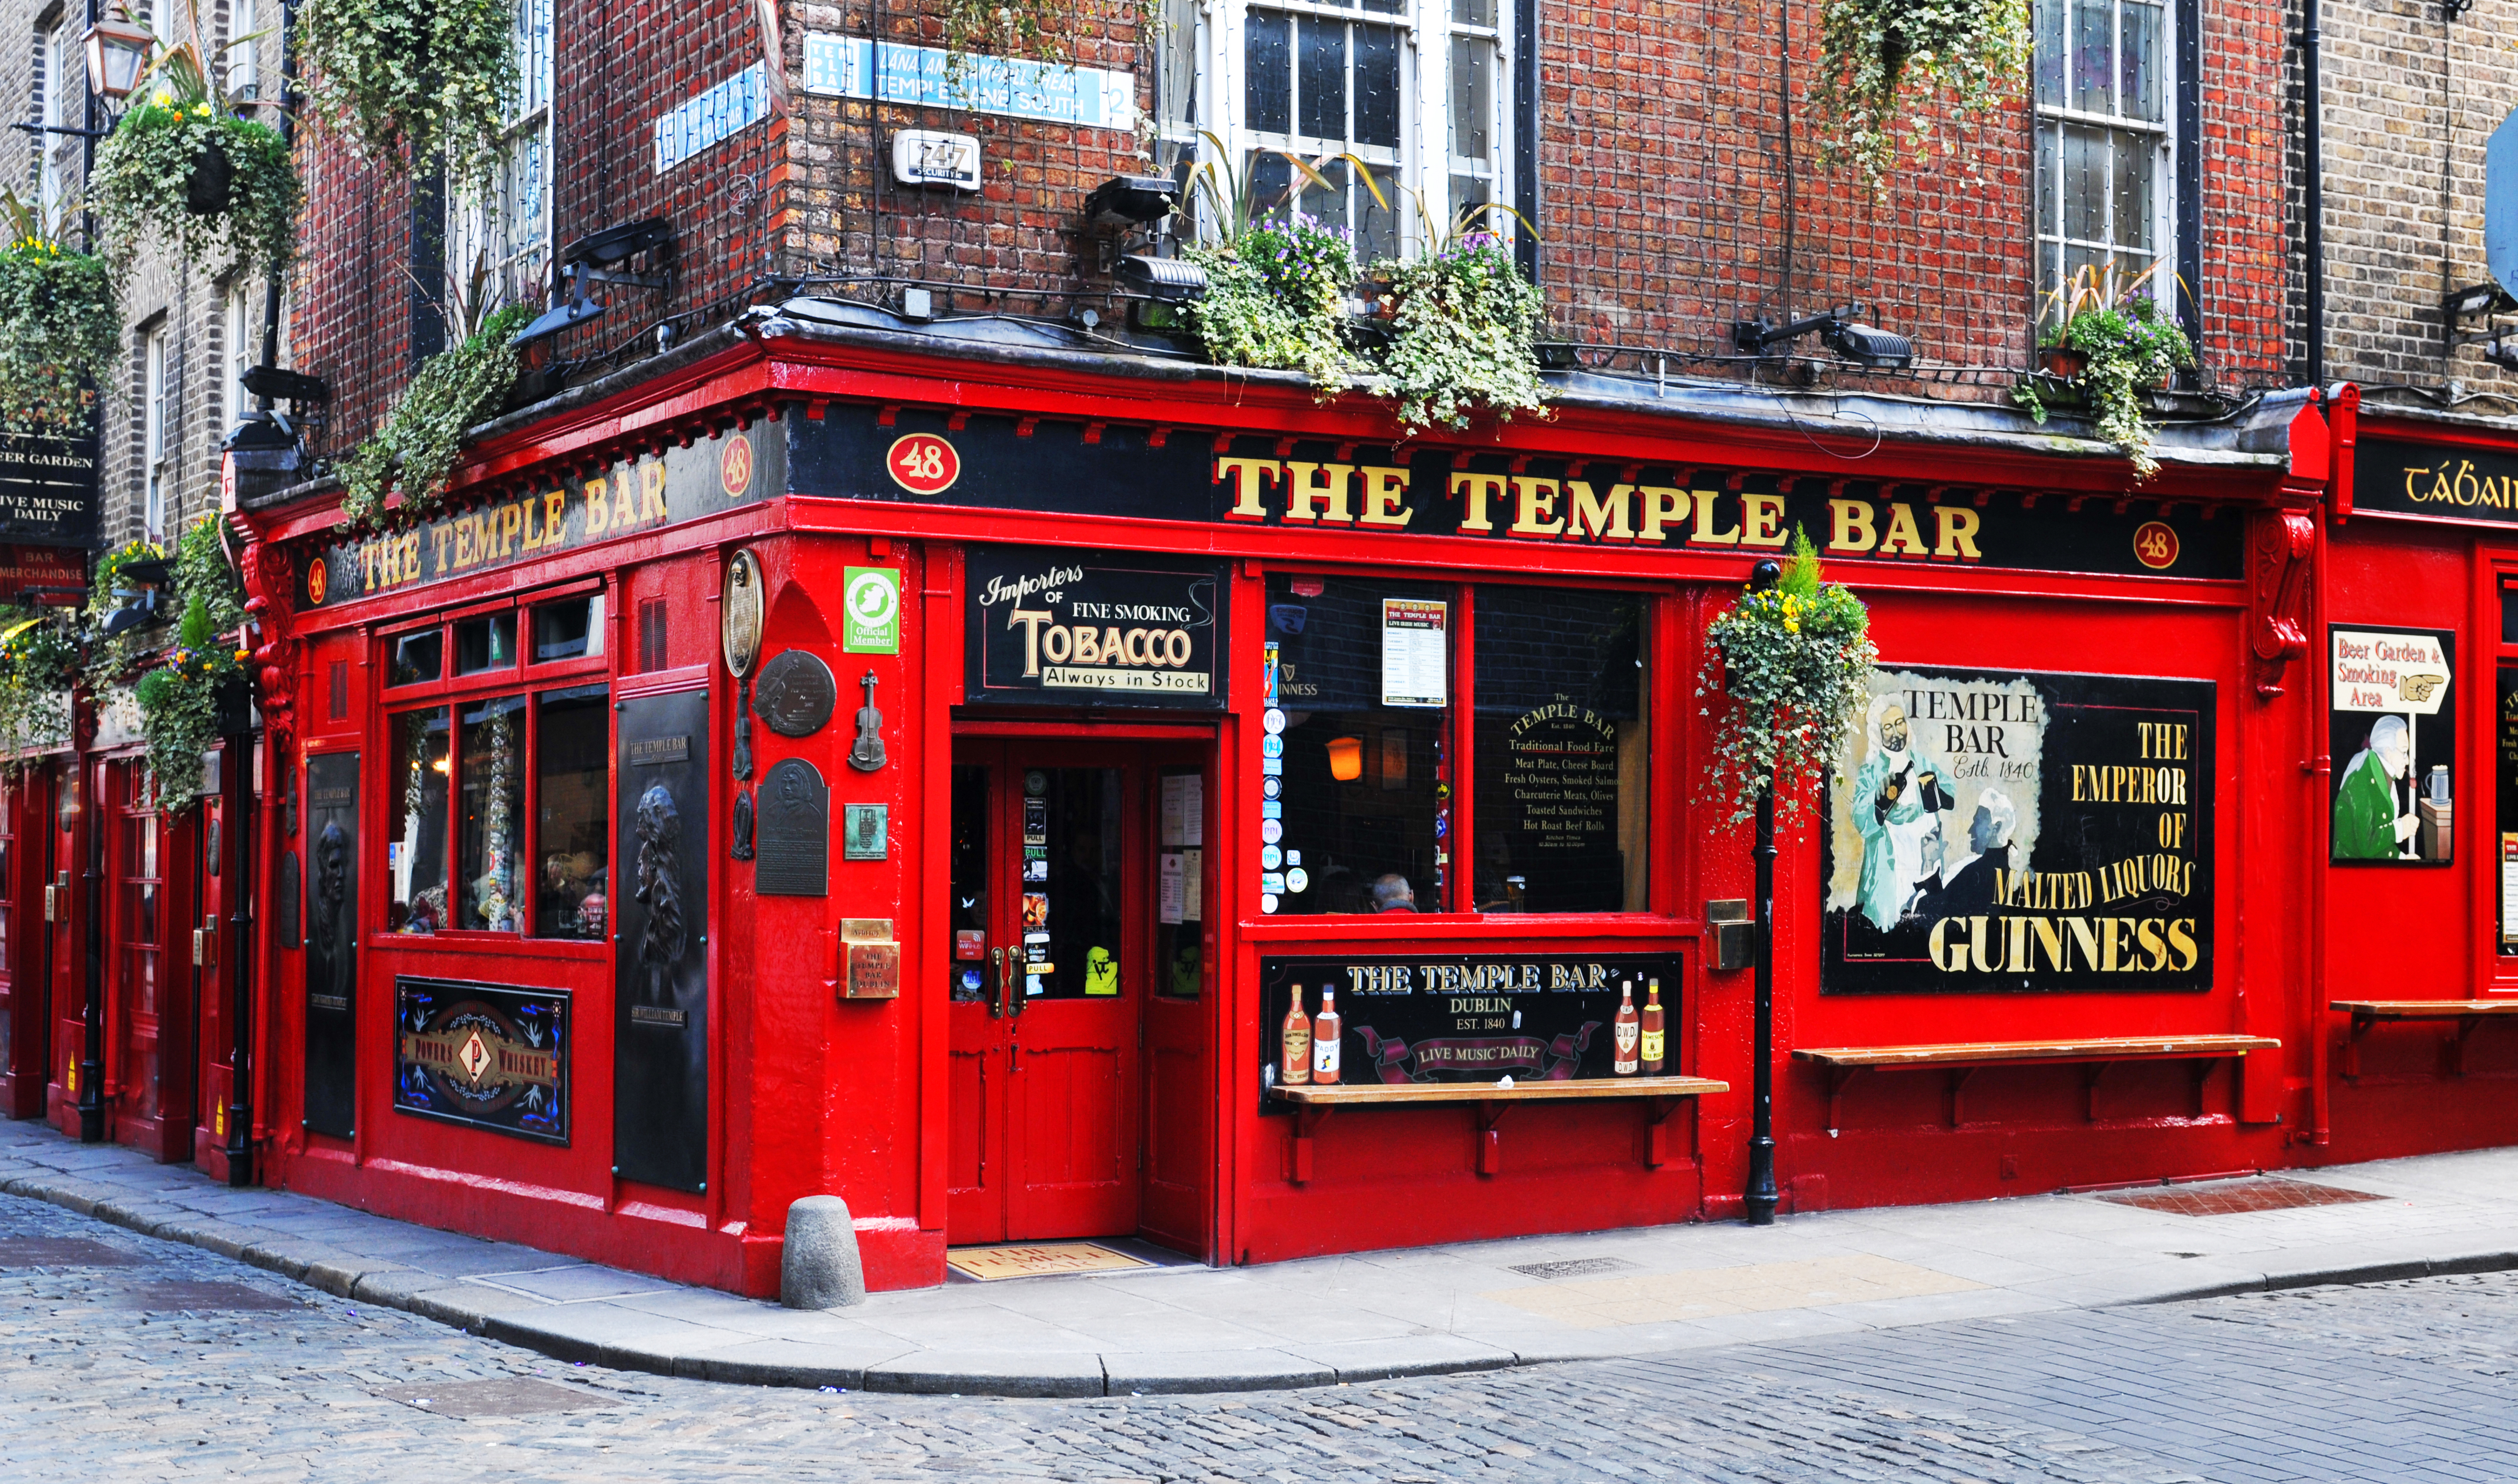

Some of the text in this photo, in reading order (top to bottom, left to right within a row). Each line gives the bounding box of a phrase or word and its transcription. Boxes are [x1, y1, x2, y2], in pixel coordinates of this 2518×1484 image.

[1018, 92, 1084, 116] SOUTH
[1109, 89, 1125, 114] 2
[29, 454, 93, 468] GARDEN
[725, 447, 745, 485] 48
[900, 441, 944, 479] 48
[0, 495, 84, 511] IVE MUSIC
[1213, 457, 1982, 562] THE TEMPLE BAR
[15, 508, 62, 521] DAILY
[359, 461, 667, 594] THE TEMPLE BAR
[2139, 527, 2169, 559] 48
[25, 552, 53, 562] BAR
[0, 567, 82, 580] MERCHANDISE
[979, 564, 1083, 609] Importers
[1045, 591, 1063, 603] OF
[1072, 602, 1191, 622] FINE SMOKING
[853, 635, 890, 645] Member
[856, 626, 888, 636] Official
[2338, 638, 2441, 665] Beer Garden &
[1046, 667, 1206, 689] Always in Stock
[2337, 662, 2398, 688] Smoking
[1279, 684, 1318, 696] INNESS
[1555, 693, 1569, 701] The
[2349, 687, 2384, 707] Area
[1903, 689, 2039, 723] TEMPLE
[1510, 704, 1614, 740] TEMPLE BAR
[630, 737, 686, 755] THE TEMPLE BAR
[1509, 739, 1614, 752] Traditional Food Fare
[1944, 724, 2009, 758] BAR
[2137, 722, 2187, 760] THE
[1516, 758, 1614, 770] Meat Plate, Cheese Board
[1953, 756, 2034, 780] Estb. 1840
[1505, 773, 1623, 787] Fresh Oysters, Smoked Salmon
[2071, 764, 2187, 805] EMPEROR
[1514, 788, 1614, 801] Charcuterie Meats, Olives
[1526, 804, 1603, 815] Toasted Sandwiches
[1523, 819, 1604, 831] Hot Roast Beef Rolls
[2159, 812, 2187, 849] OF
[1991, 852, 2196, 910] MALTED LIQUORS
[1928, 916, 2198, 973] GUINNESS
[1347, 963, 1609, 994] THE TEMPLE BAR
[1450, 998, 1512, 1013] DUBLIN
[1456, 1018, 1505, 1030] EST. 1840
[1617, 1026, 1637, 1037] D.W.D.
[415, 1037, 452, 1062] POWERS
[1315, 1041, 1339, 1053] PADDY
[1419, 1046, 1539, 1063] LIVE MUSIC DAILY
[470, 1039, 482, 1076] P
[499, 1048, 547, 1077] WHISKEY
[1618, 1063, 1634, 1072] D.W.D.
[957, 1251, 1116, 1267] TEMPLE
[978, 1247, 1050, 1257] THE
[1019, 1260, 1103, 1271] BAR
